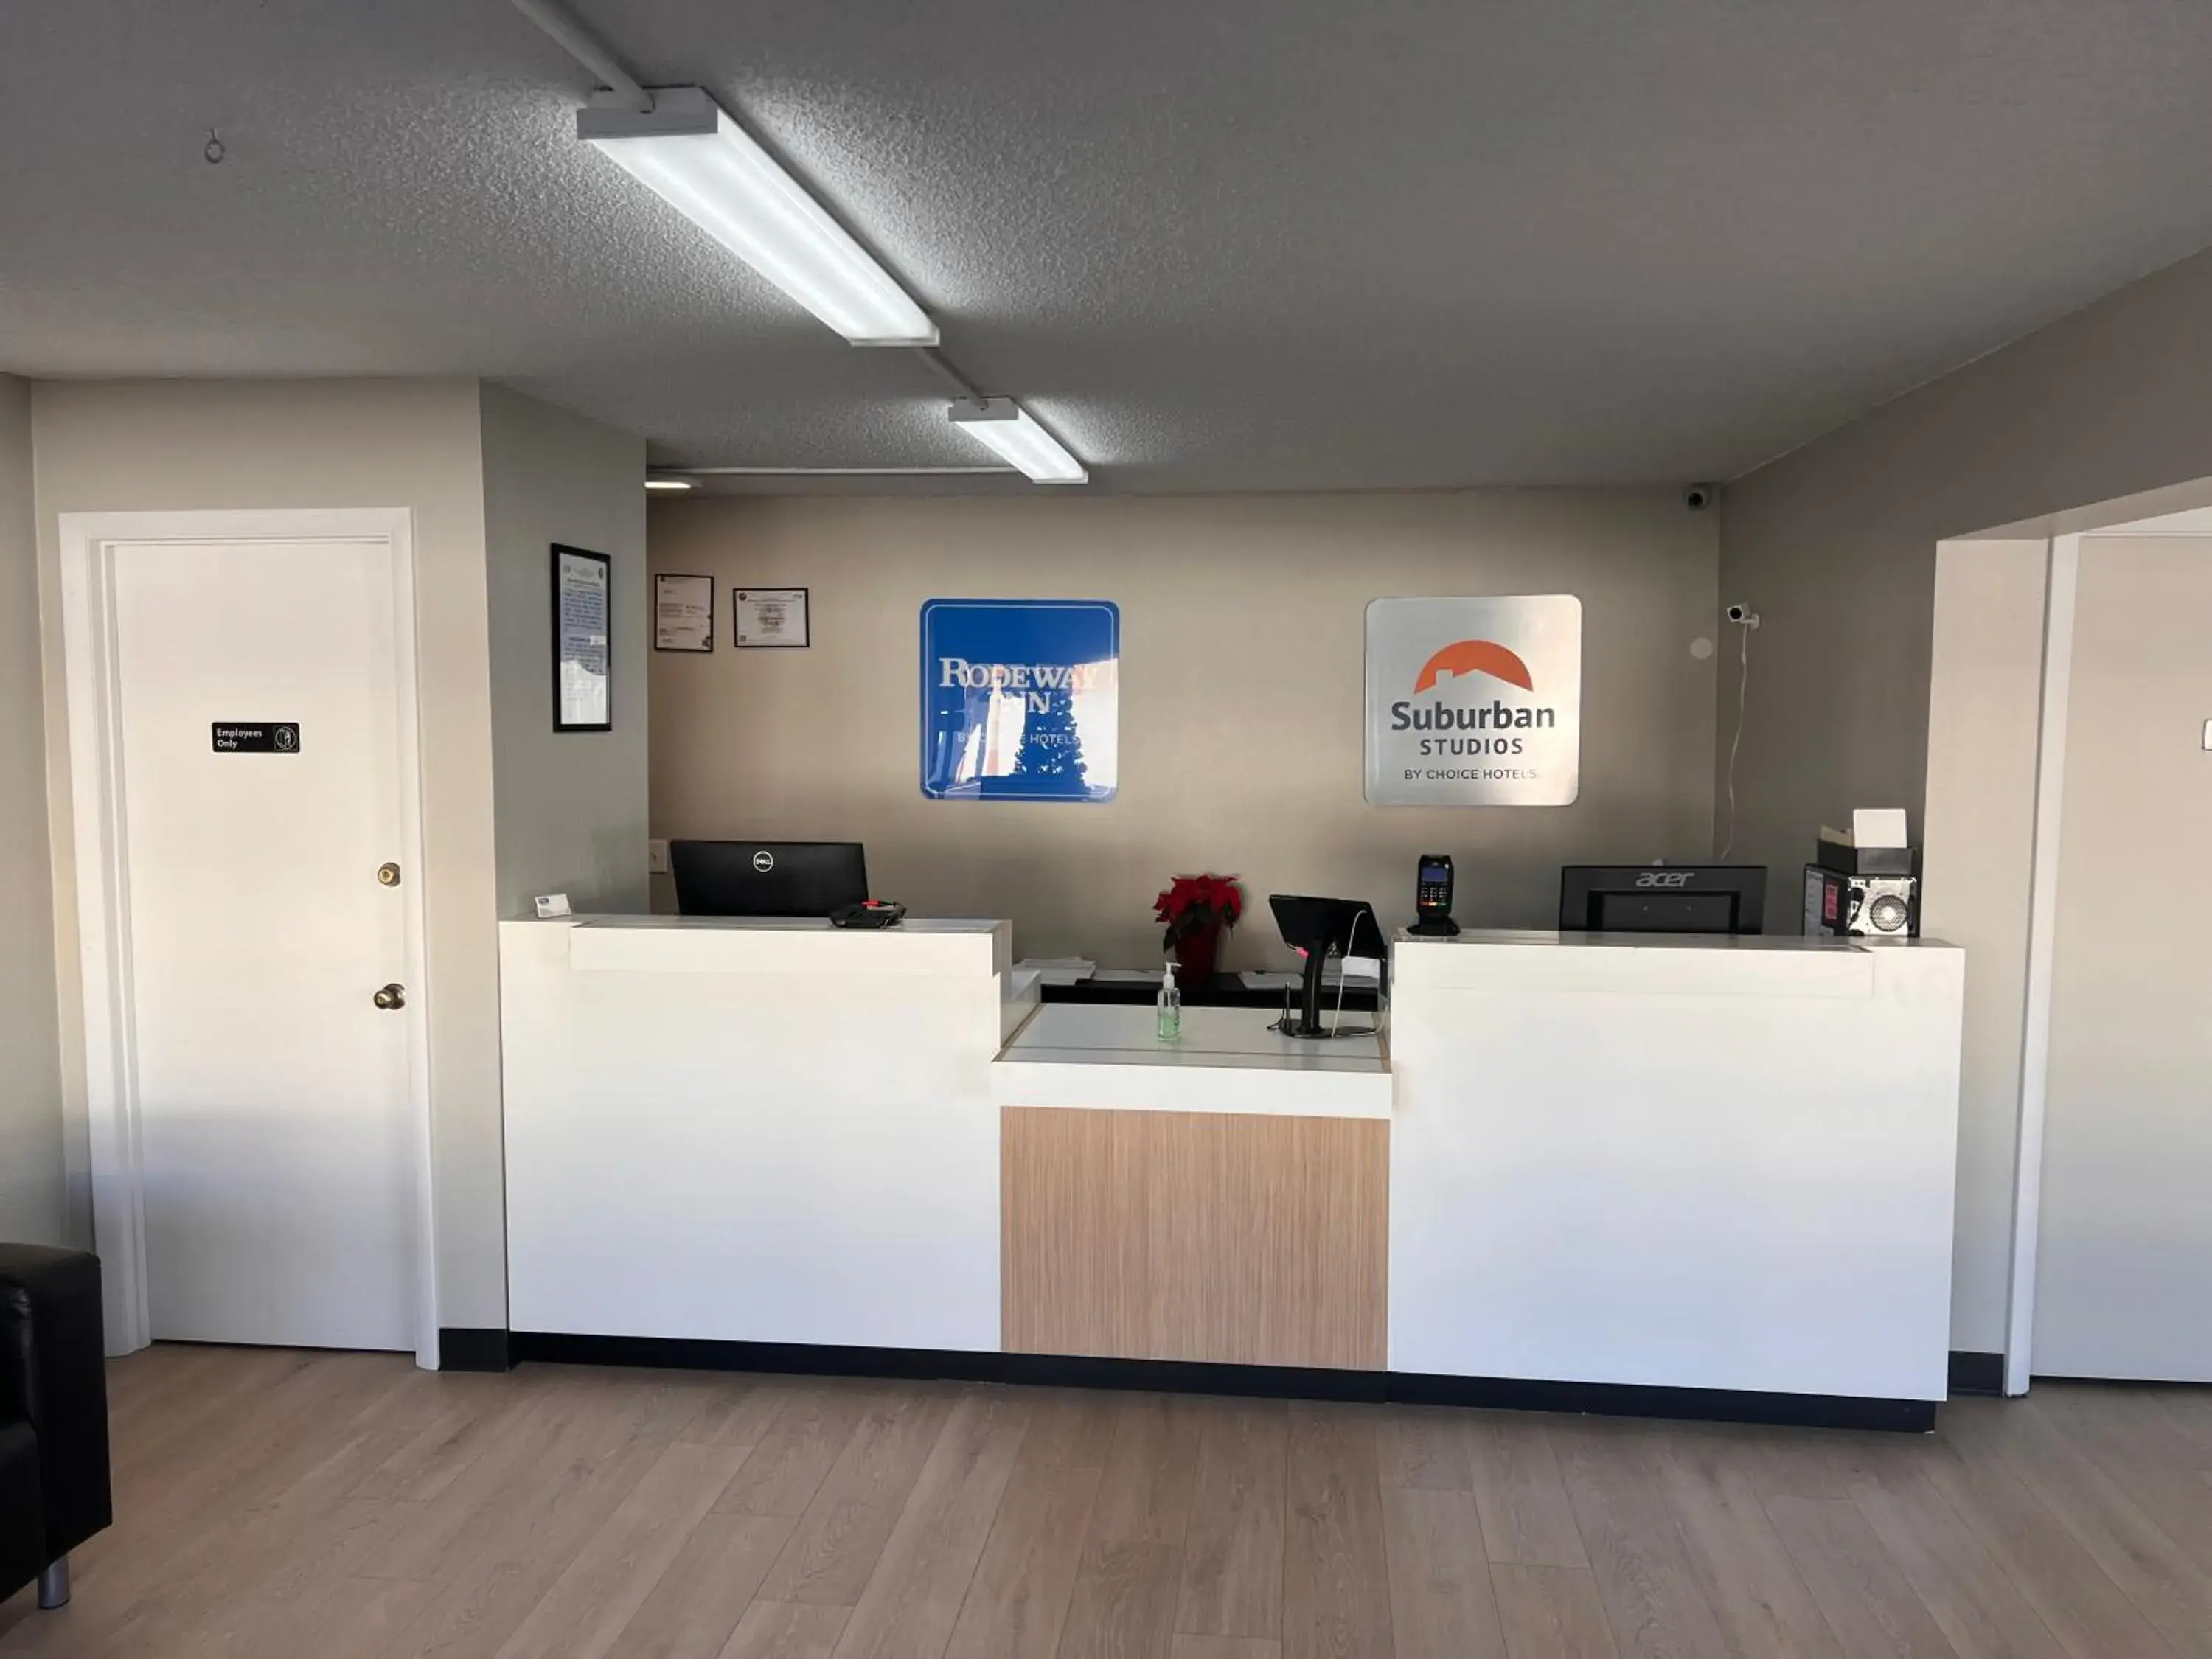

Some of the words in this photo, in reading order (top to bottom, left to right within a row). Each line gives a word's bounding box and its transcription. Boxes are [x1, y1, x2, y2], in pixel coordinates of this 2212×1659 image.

[1391, 700, 1556, 731] Suburban
[217, 728, 262, 739] Employees
[1030, 734, 1081, 744] HOTELS
[218, 740, 237, 749] Only
[1419, 737, 1523, 756] STUDIOS
[1404, 769, 1422, 779] BY
[1426, 769, 1478, 779] CHOICE
[1483, 769, 1537, 779] HOTELS
[1635, 872, 1695, 887] acer
